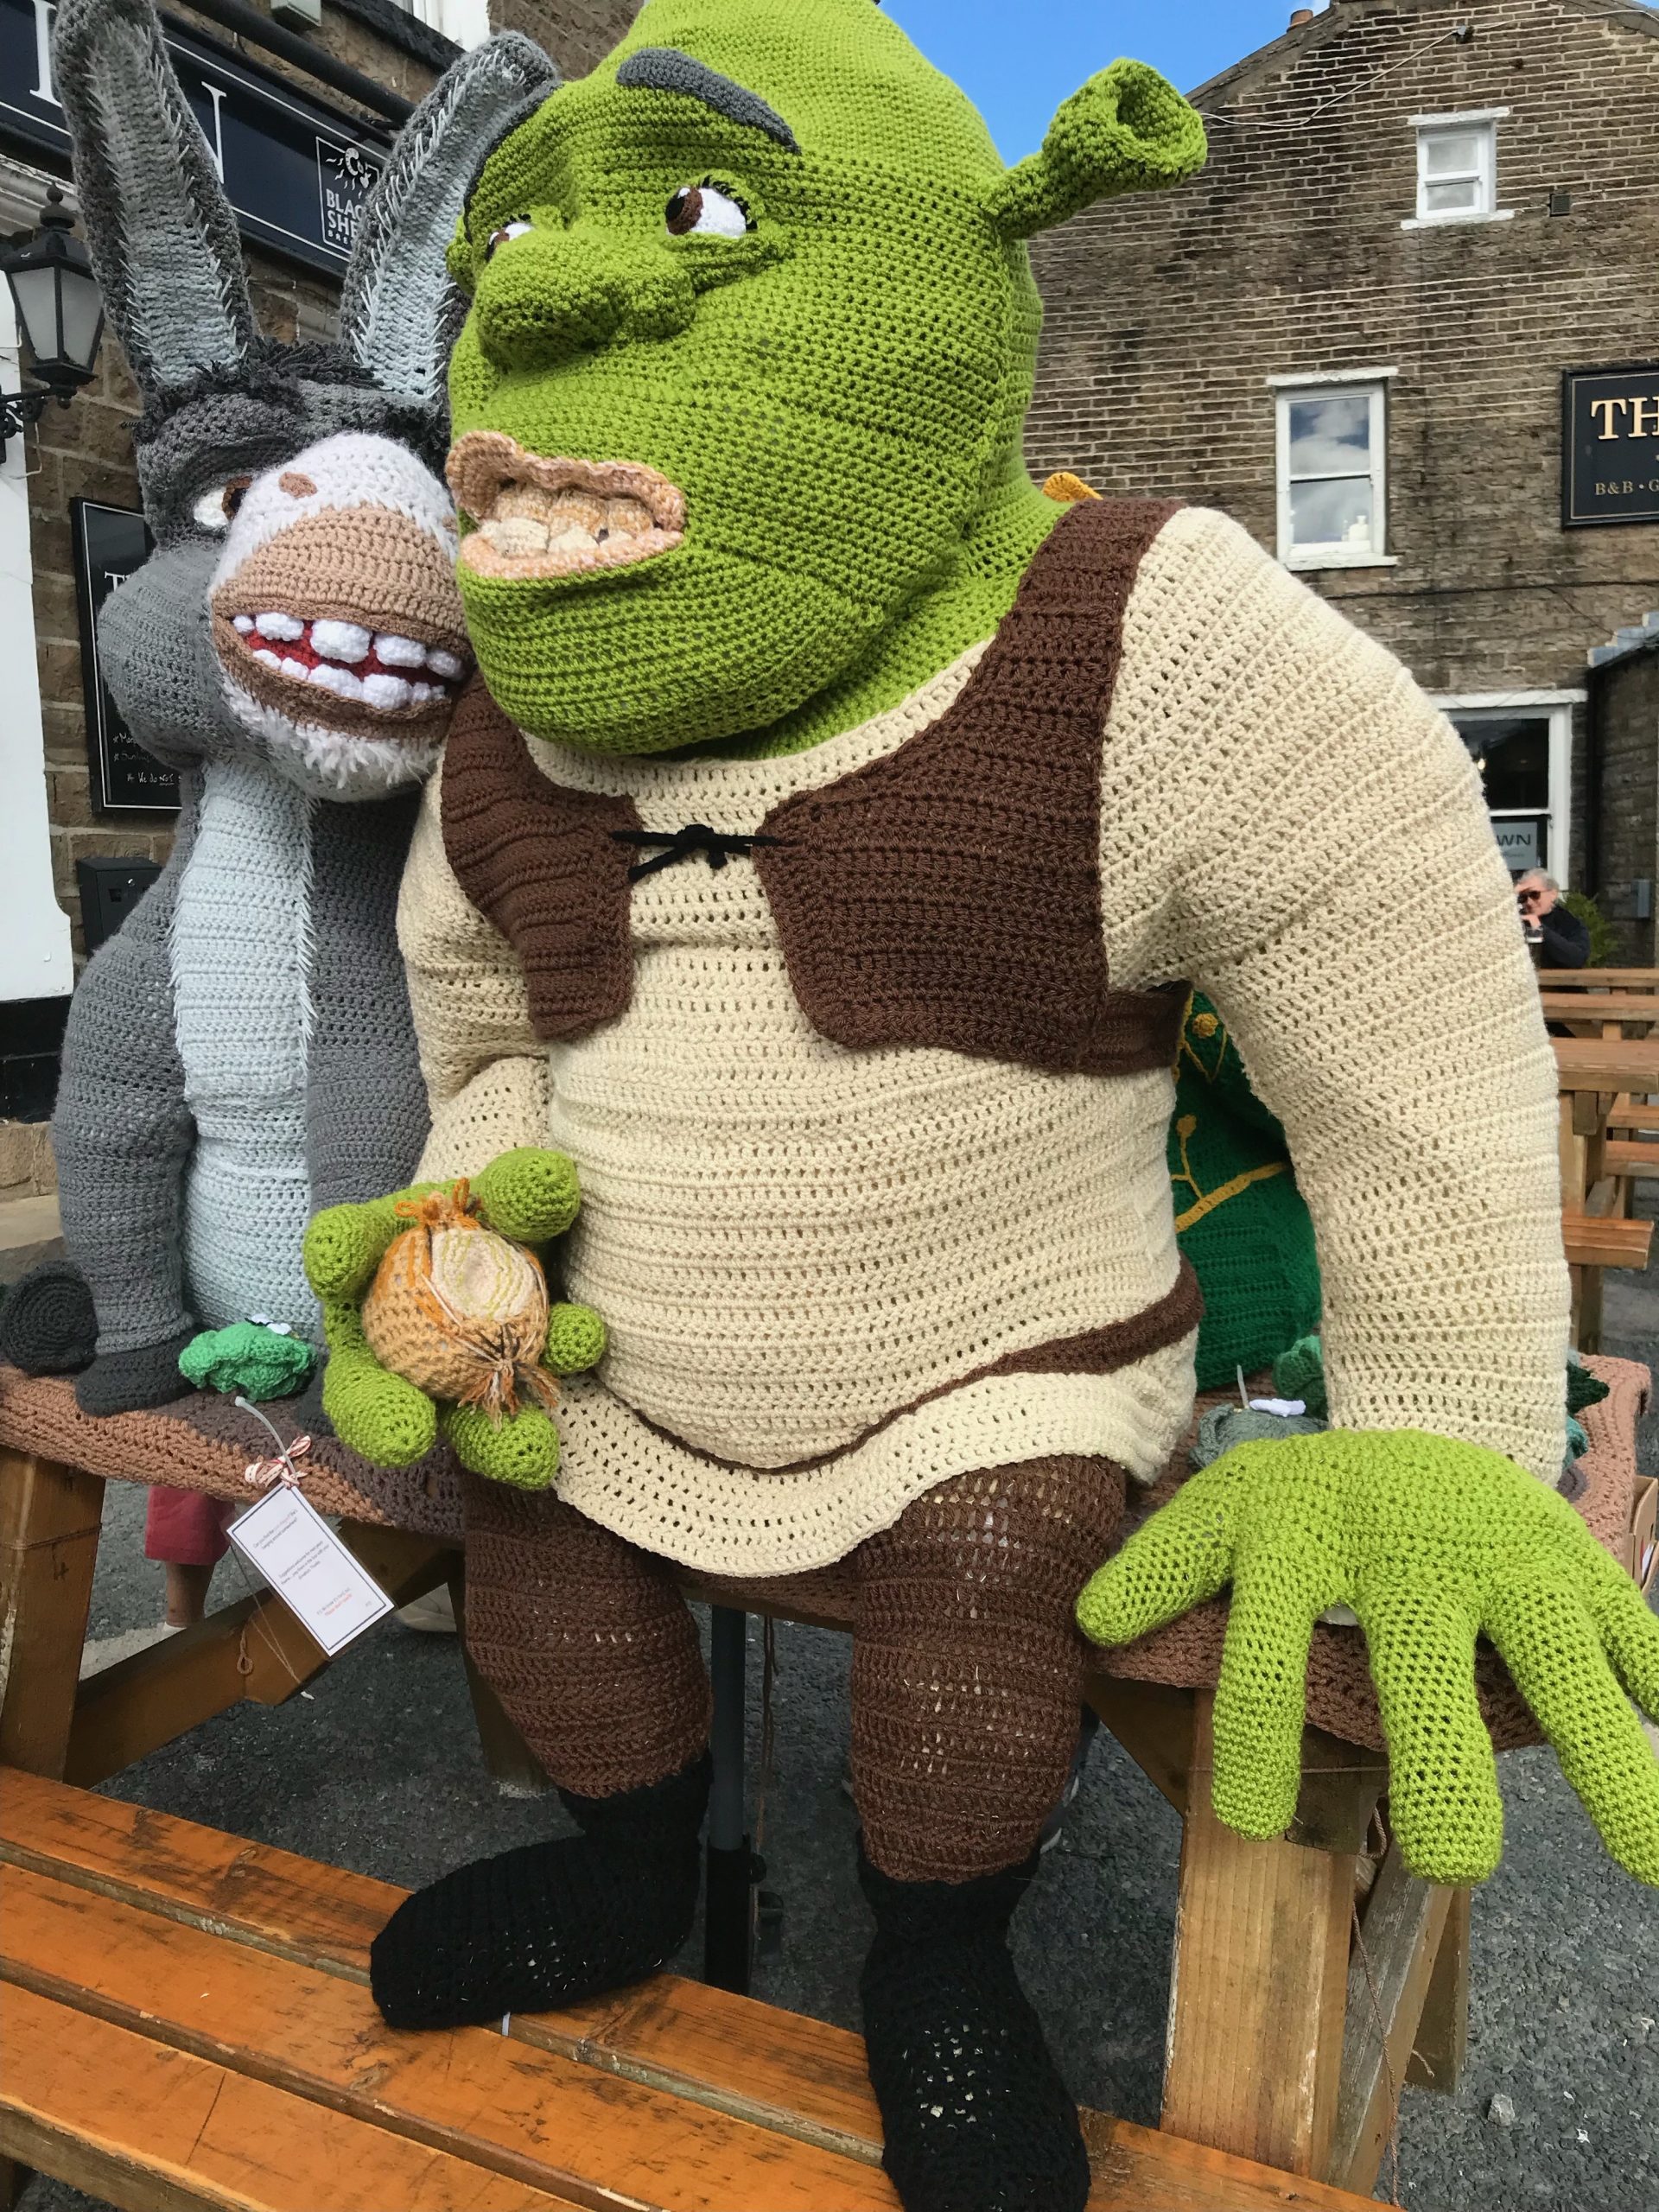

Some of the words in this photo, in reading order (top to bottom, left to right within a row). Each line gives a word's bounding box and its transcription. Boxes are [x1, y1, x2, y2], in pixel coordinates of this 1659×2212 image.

[326, 188, 366, 221] BLAC
[327, 210, 359, 238] SHE
[1591, 396, 1659, 440] TH
[1594, 480, 1633, 496] B&B
[1496, 833, 1531, 846] WN
